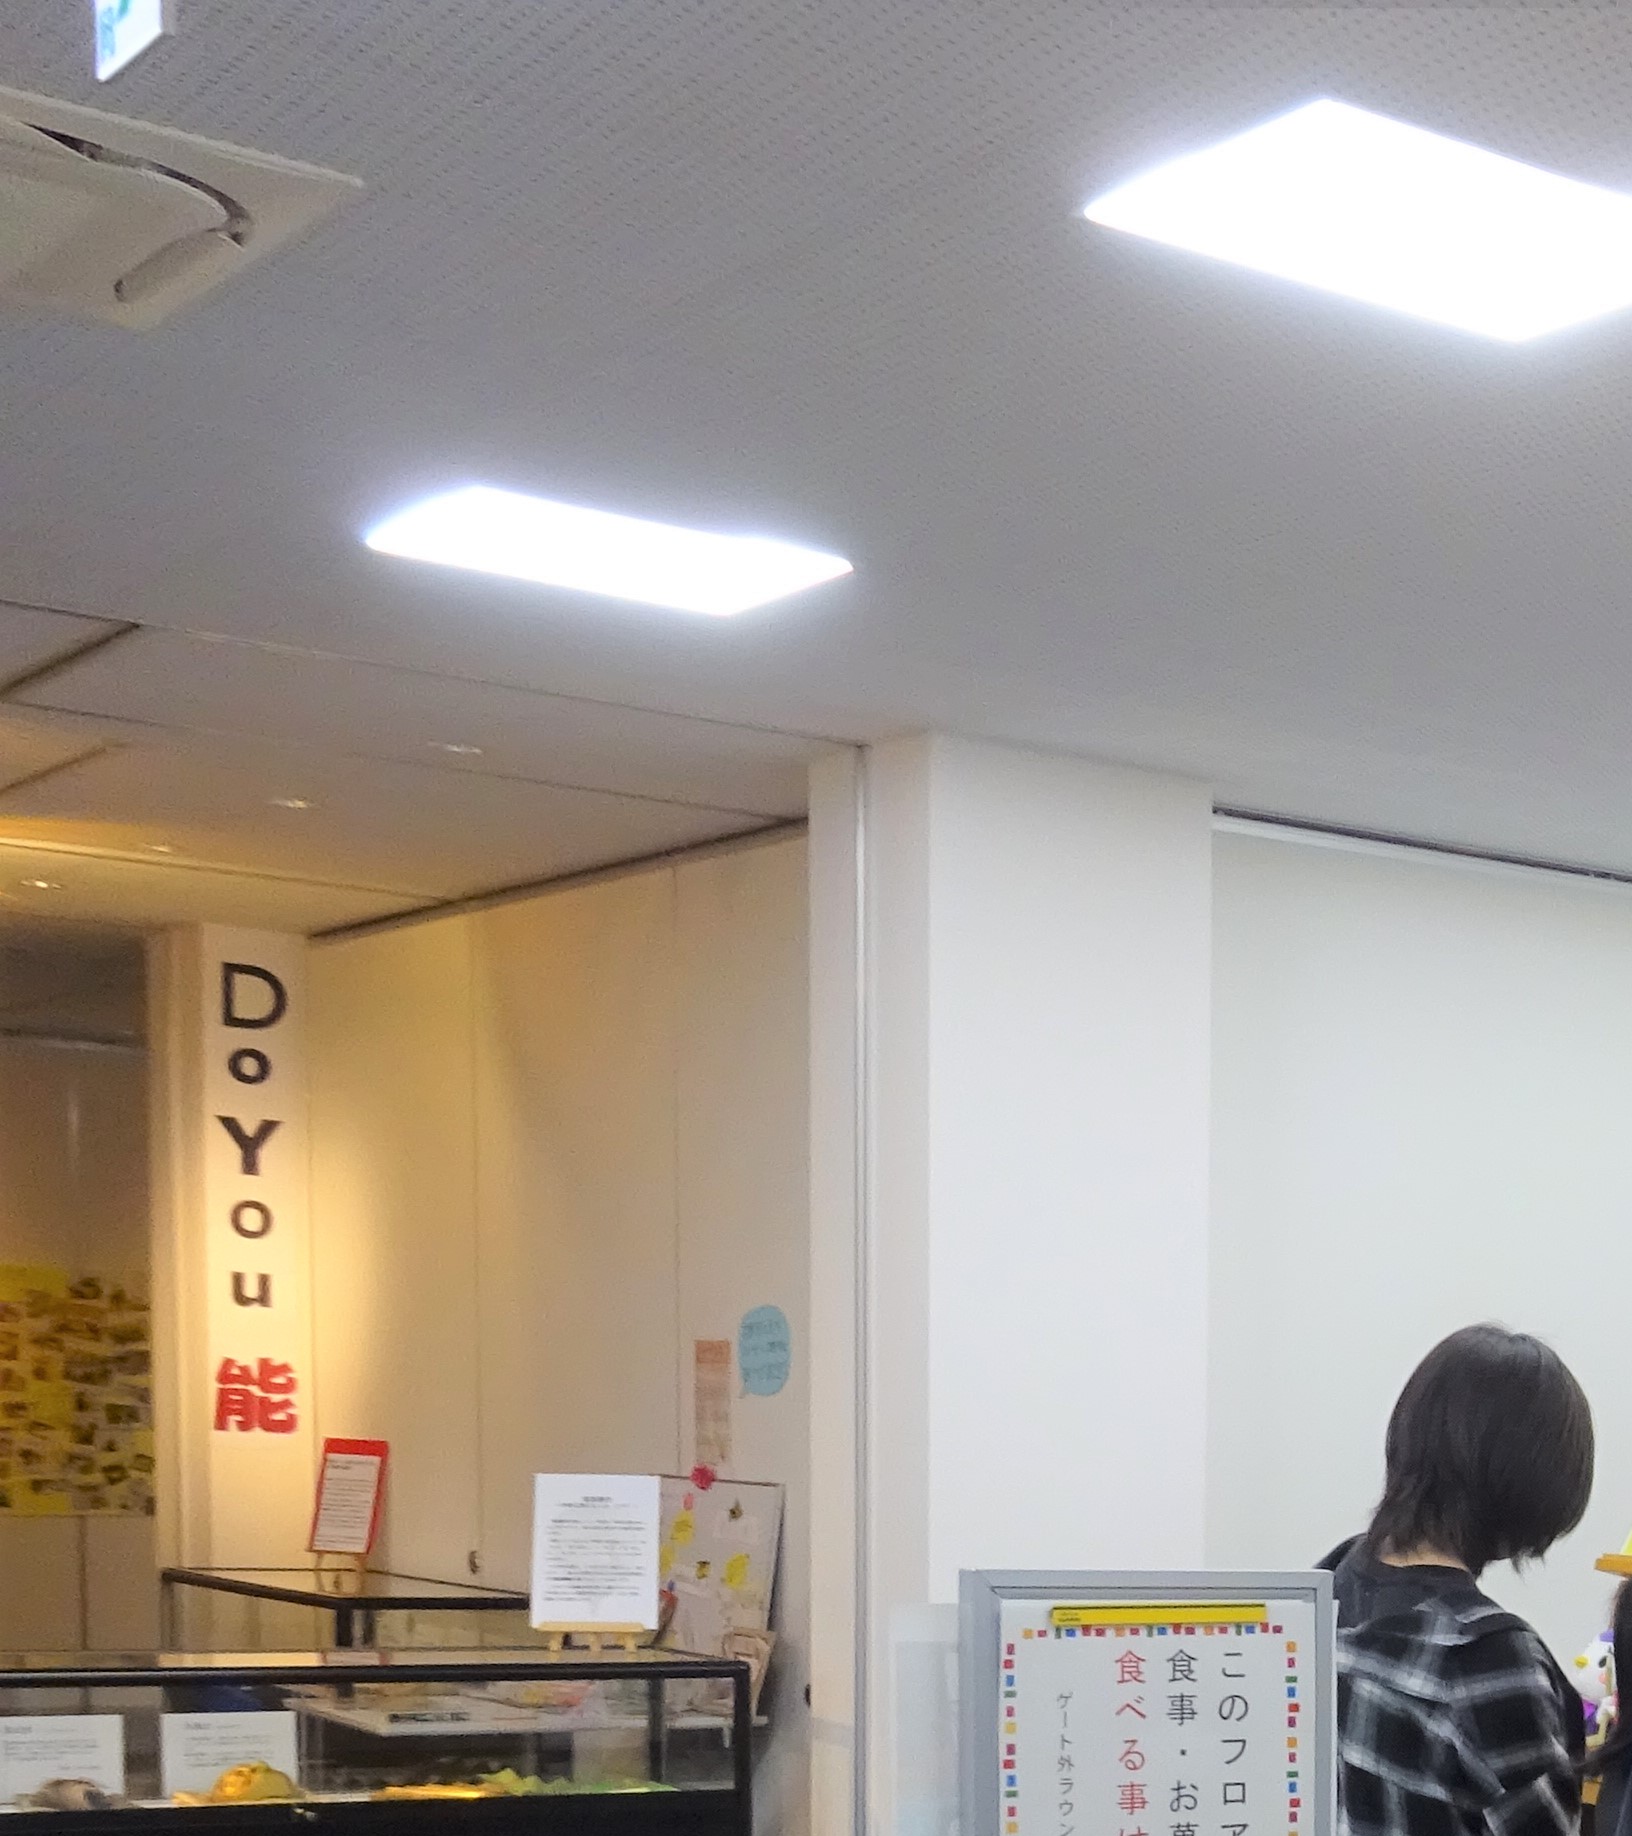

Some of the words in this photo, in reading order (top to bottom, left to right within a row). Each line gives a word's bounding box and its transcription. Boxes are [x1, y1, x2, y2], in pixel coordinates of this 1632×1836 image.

[220, 962, 289, 1086] Do
[216, 1114, 282, 1309] You
[213, 1357, 299, 1434] 能
